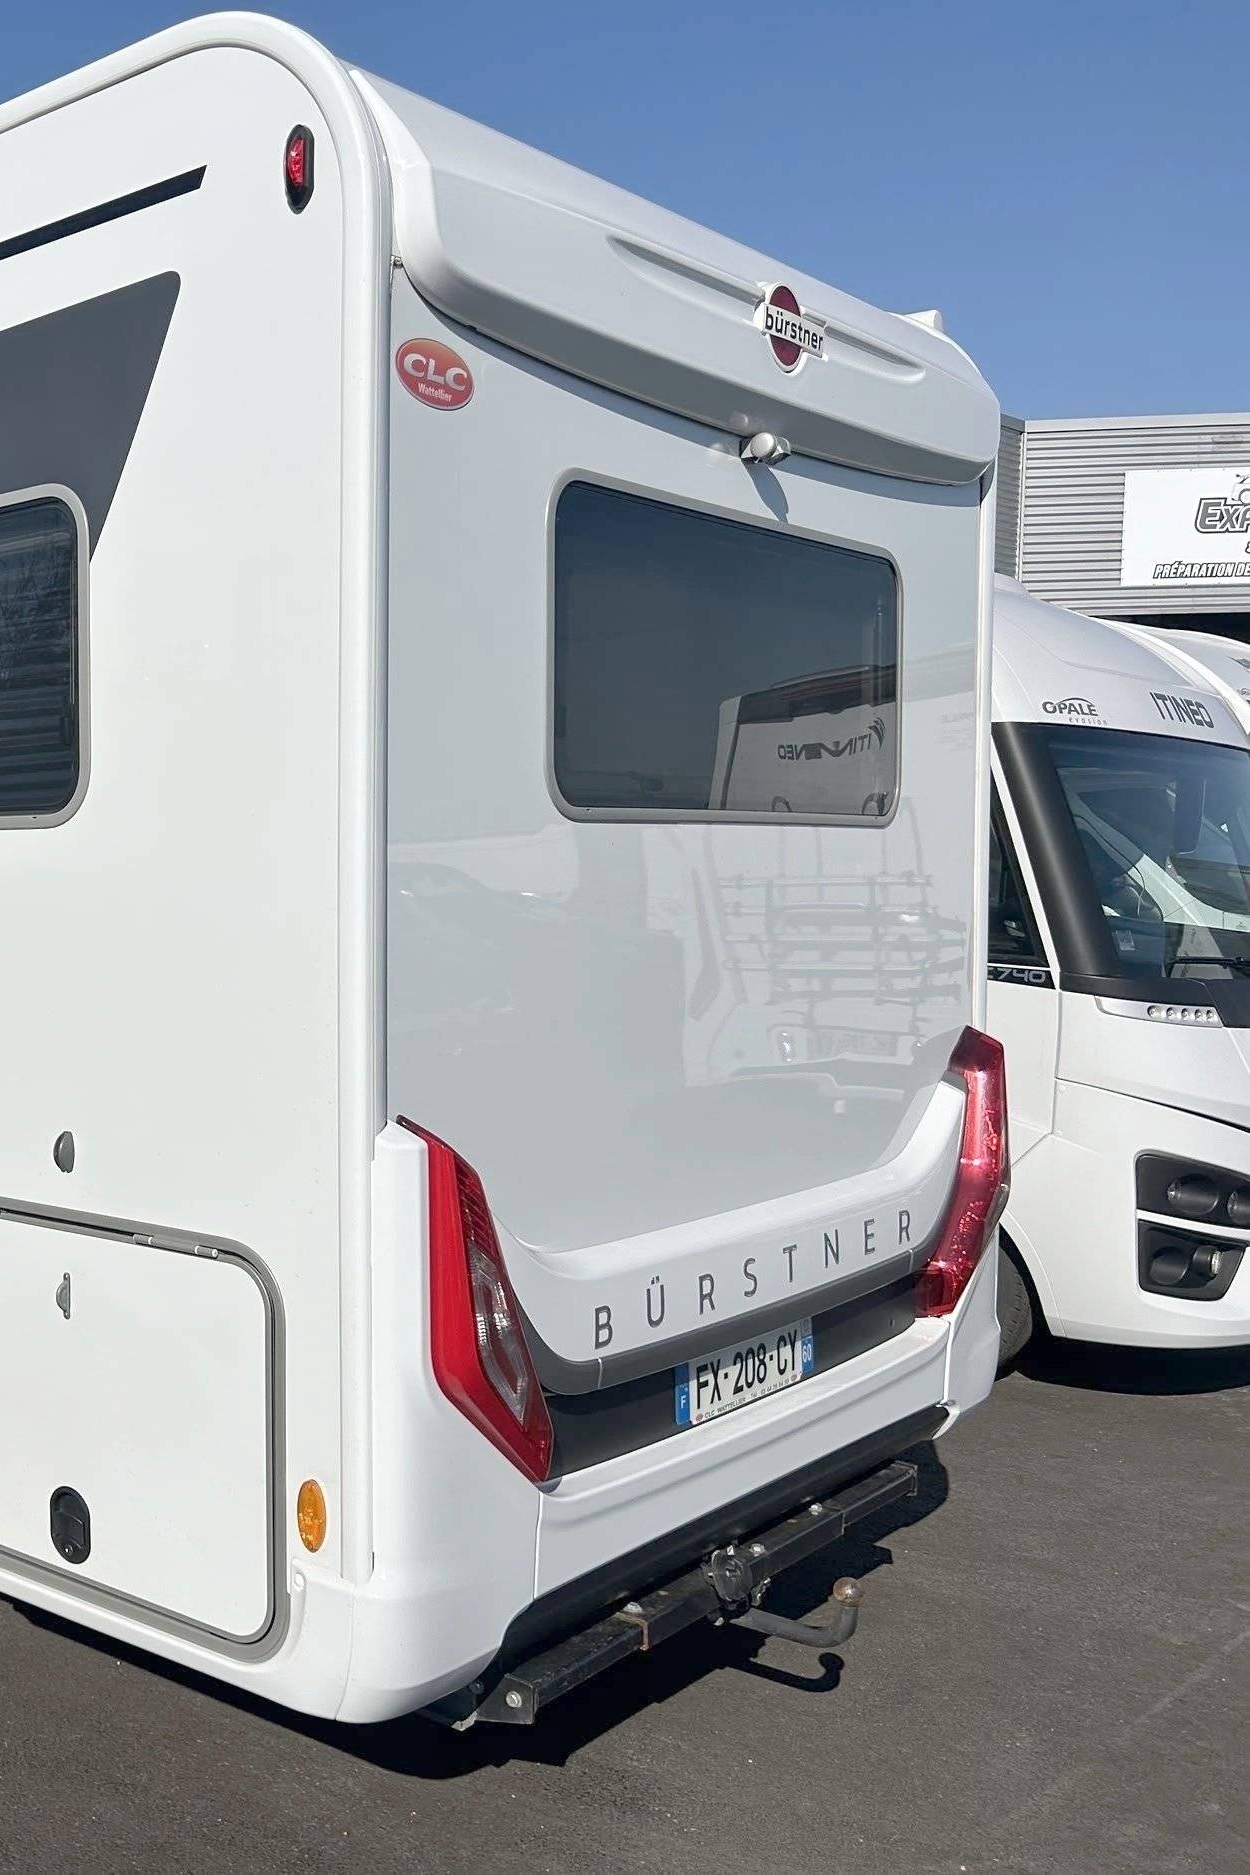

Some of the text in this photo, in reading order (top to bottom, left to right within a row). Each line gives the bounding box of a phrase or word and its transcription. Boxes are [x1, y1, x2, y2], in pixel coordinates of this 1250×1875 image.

[764, 306, 824, 352] bürstner
[403, 352, 468, 391] CLC
[1153, 560, 1236, 579] PRÉPARATION
[1042, 699, 1099, 717] OPALE
[1149, 691, 1215, 729] ITINEO
[594, 1209, 912, 1351] BÜRSTNER
[802, 1342, 812, 1364] 60
[680, 1394, 687, 1410] F
